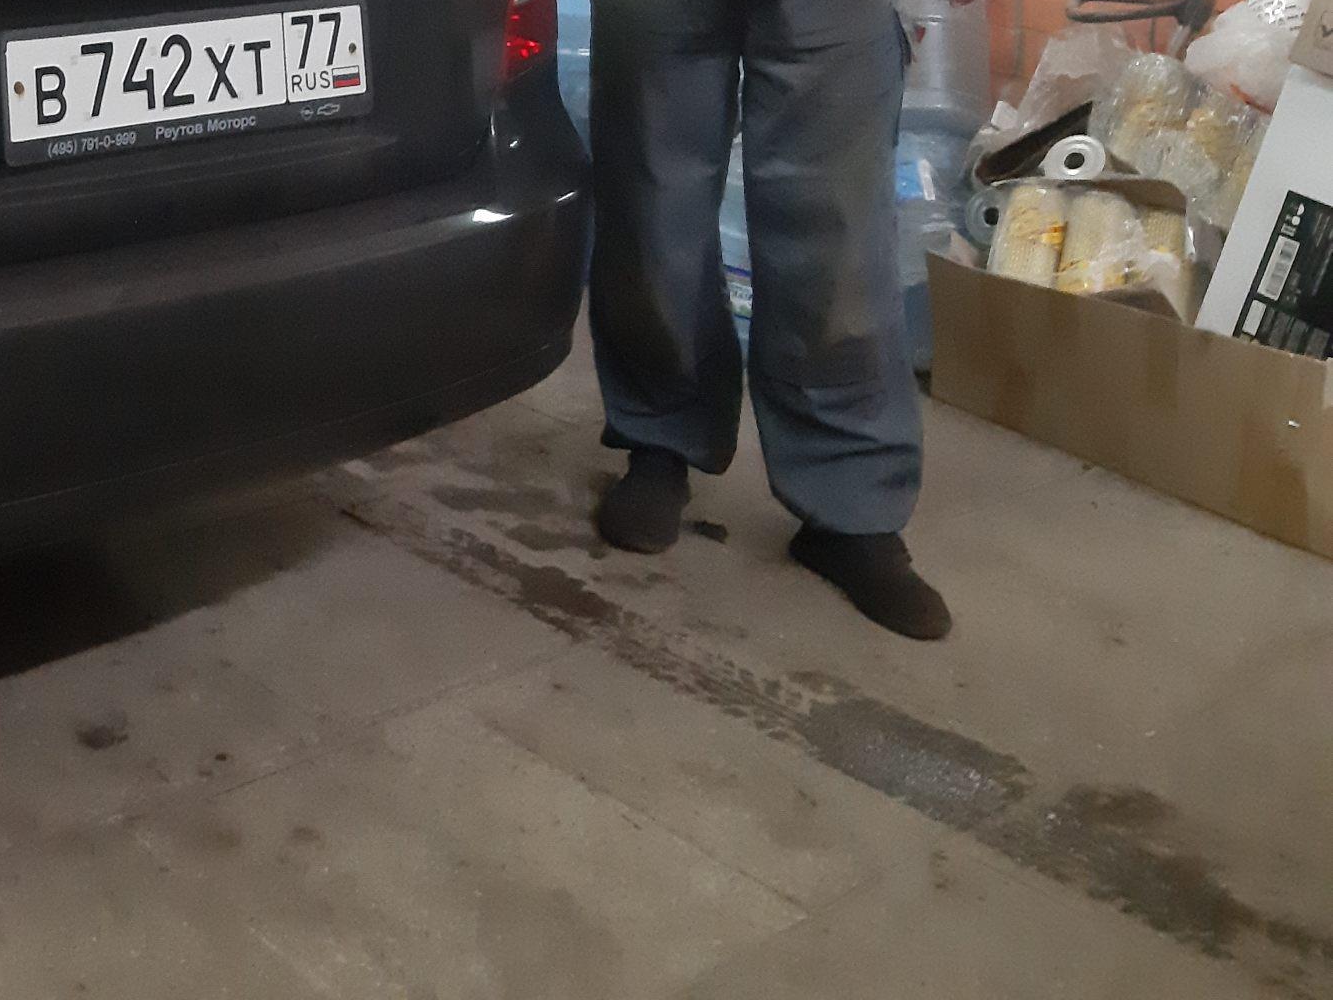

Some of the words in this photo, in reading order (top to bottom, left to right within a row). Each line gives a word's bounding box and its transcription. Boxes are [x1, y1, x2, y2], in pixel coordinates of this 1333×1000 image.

[291, 12, 342, 70] 77
[291, 70, 331, 94] RUS
[155, 123, 204, 142] Реутов
[207, 115, 257, 134] Моторс
